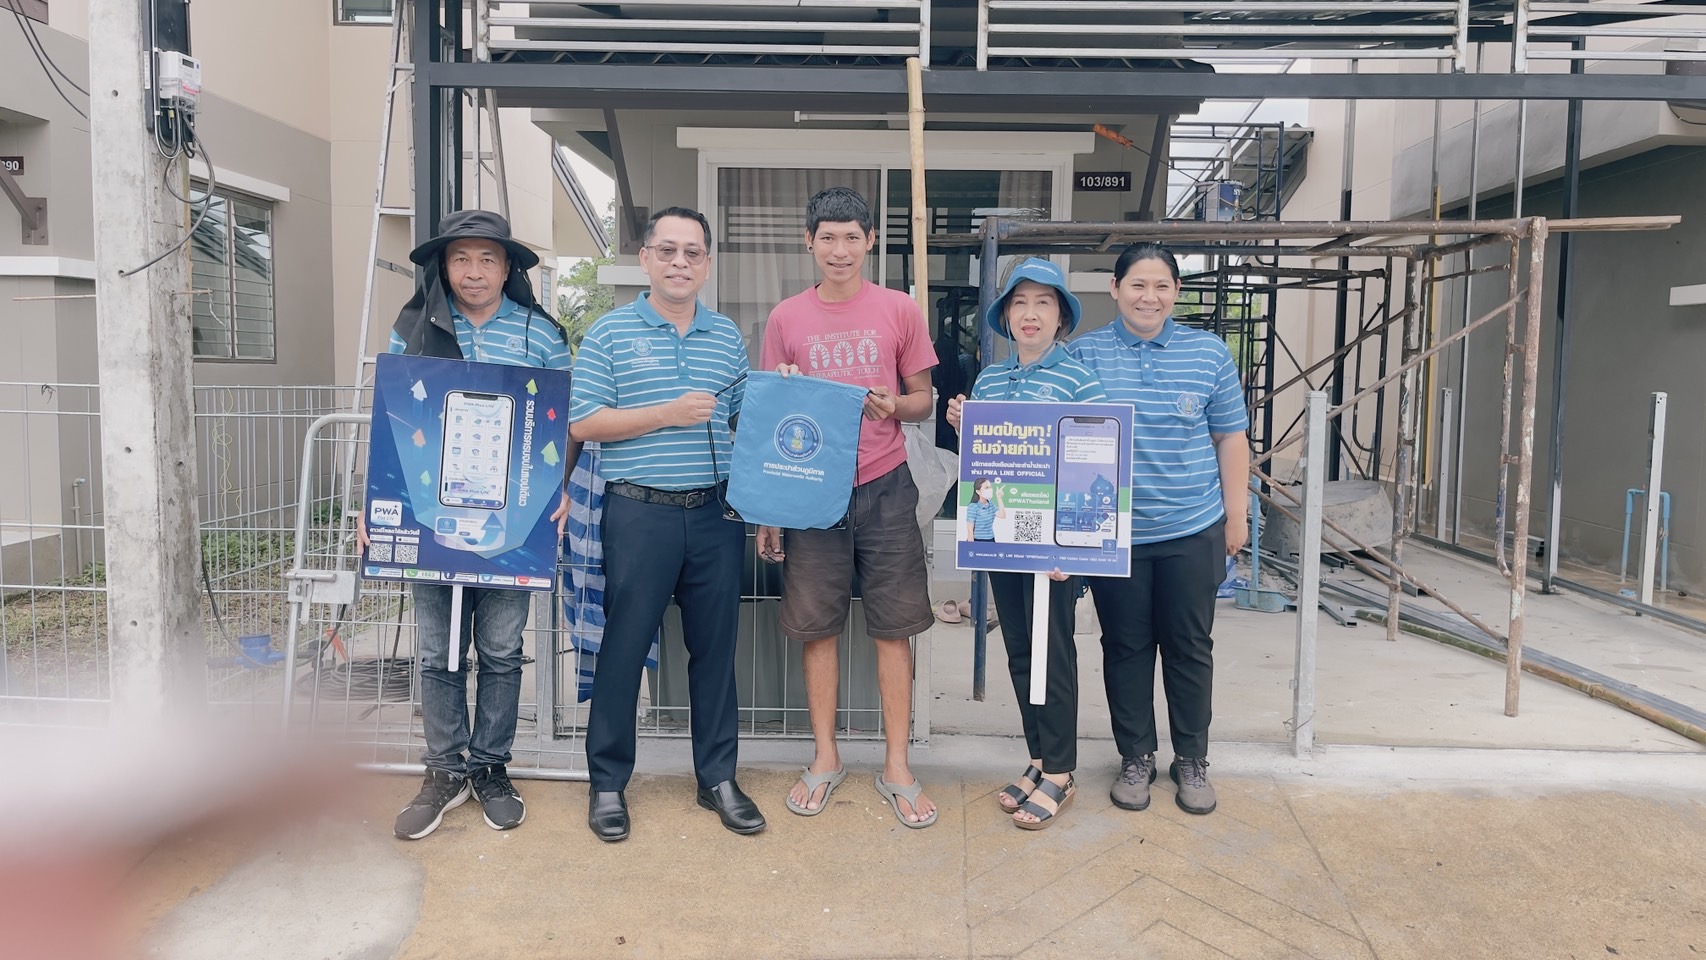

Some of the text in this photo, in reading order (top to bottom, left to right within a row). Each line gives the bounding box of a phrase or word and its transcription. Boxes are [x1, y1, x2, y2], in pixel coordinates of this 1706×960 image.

[0, 160, 20, 171] 90
[1080, 176, 1126, 188] 103/891
[806, 335, 821, 343] THE
[824, 330, 861, 340] INSTITUTE
[857, 367, 880, 375] TOUCH
[972, 438, 1051, 456] ลืมจ่ายค่าน้ำ
[763, 462, 825, 476] การประปาส่วนภูมิภาค
[374, 507, 399, 516] PWA
